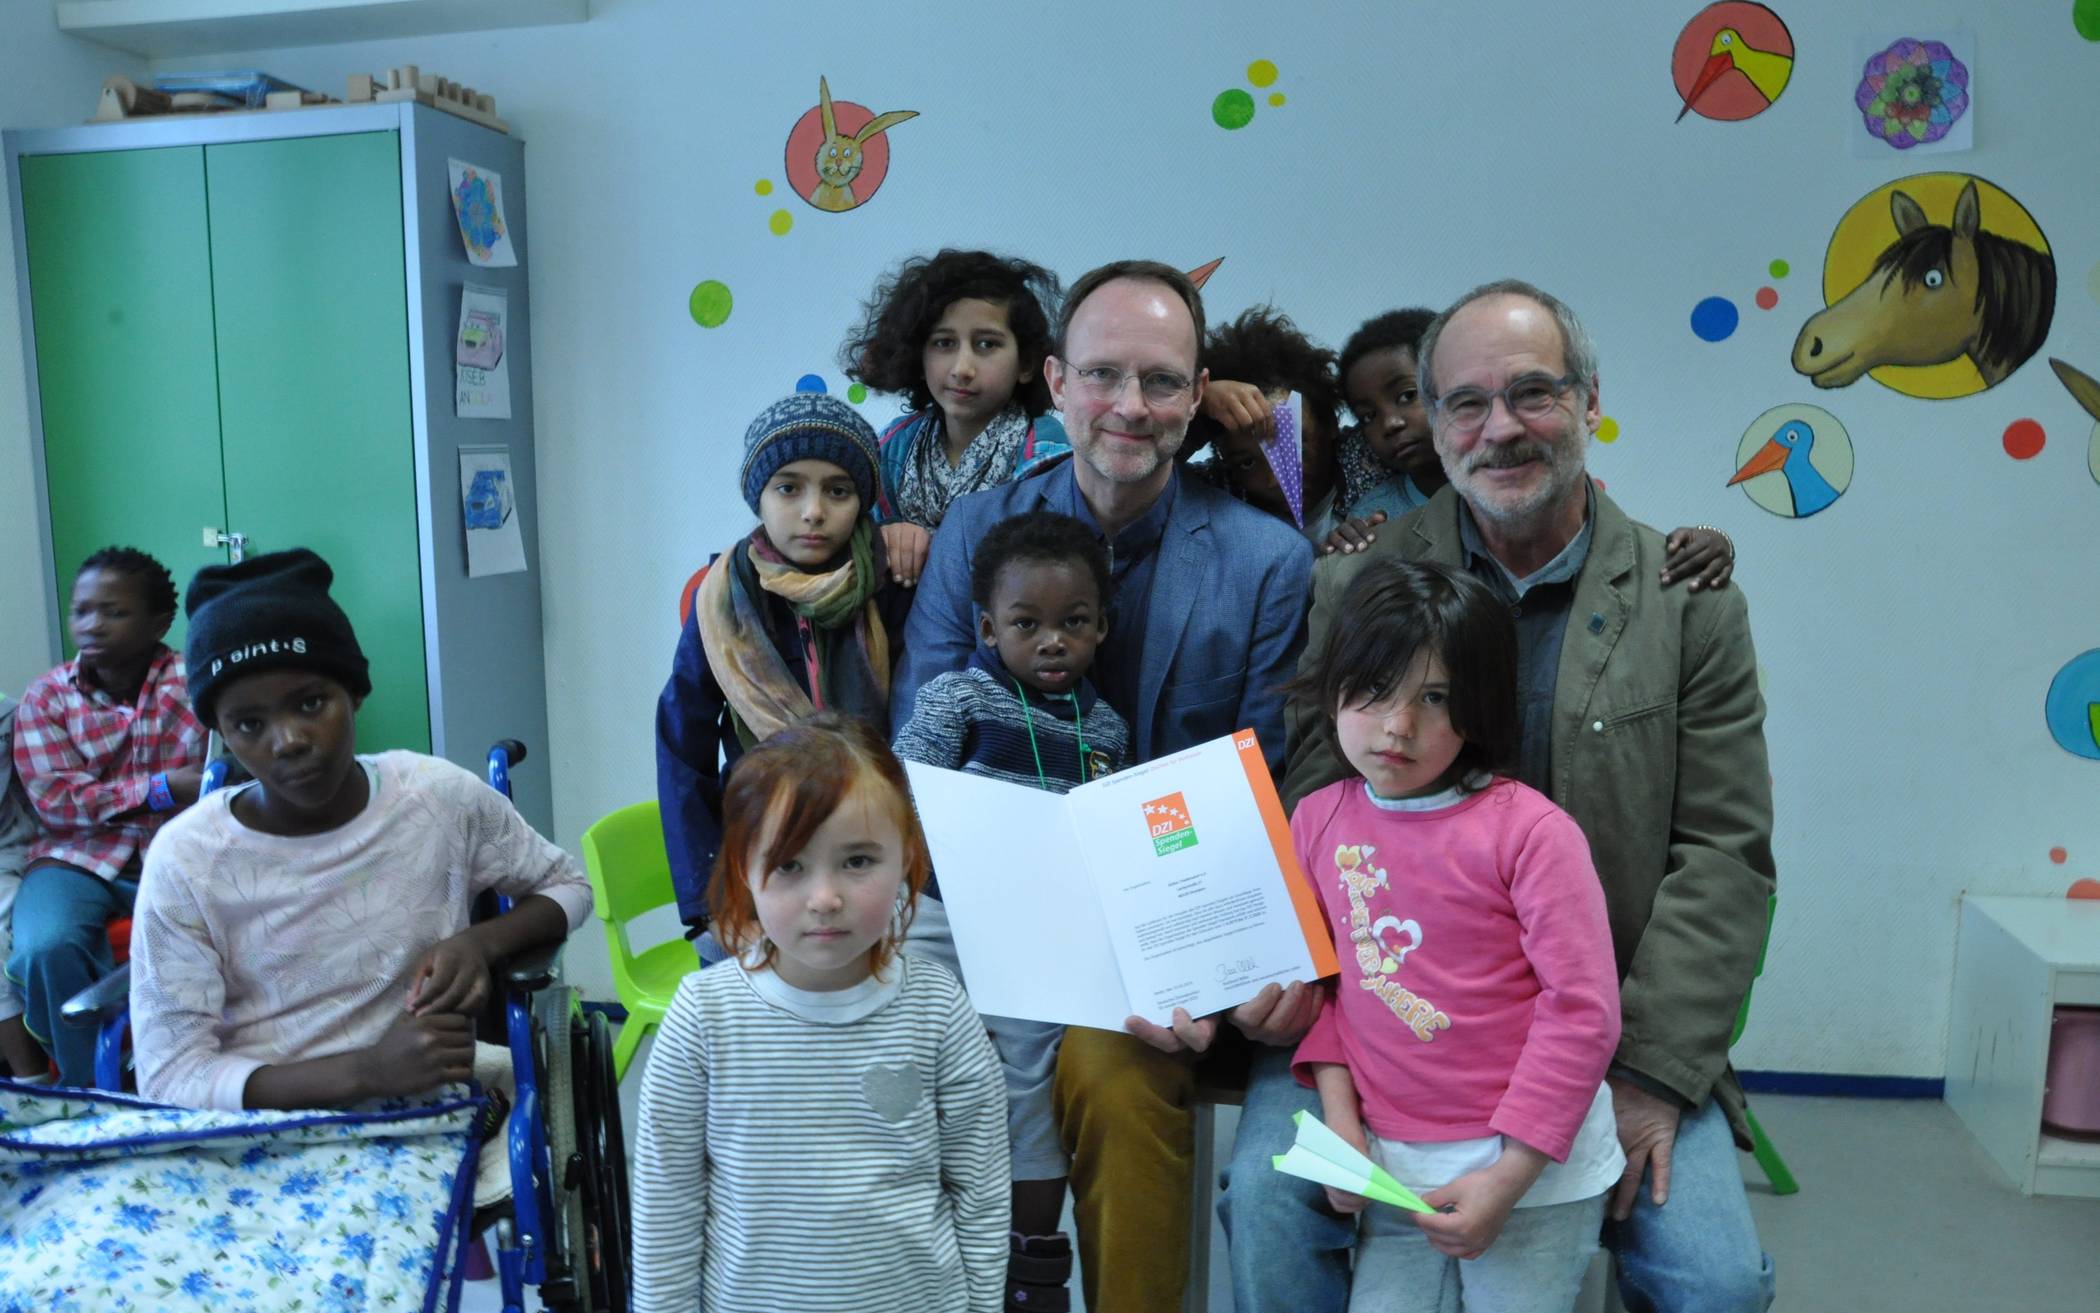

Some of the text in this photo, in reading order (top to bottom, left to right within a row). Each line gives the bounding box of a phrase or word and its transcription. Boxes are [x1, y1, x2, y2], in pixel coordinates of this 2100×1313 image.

[1238, 737, 1255, 750] DZI
[1152, 820, 1173, 836] DZI
[1154, 829, 1193, 847] Spenden-
[1157, 840, 1183, 855] Siegel
